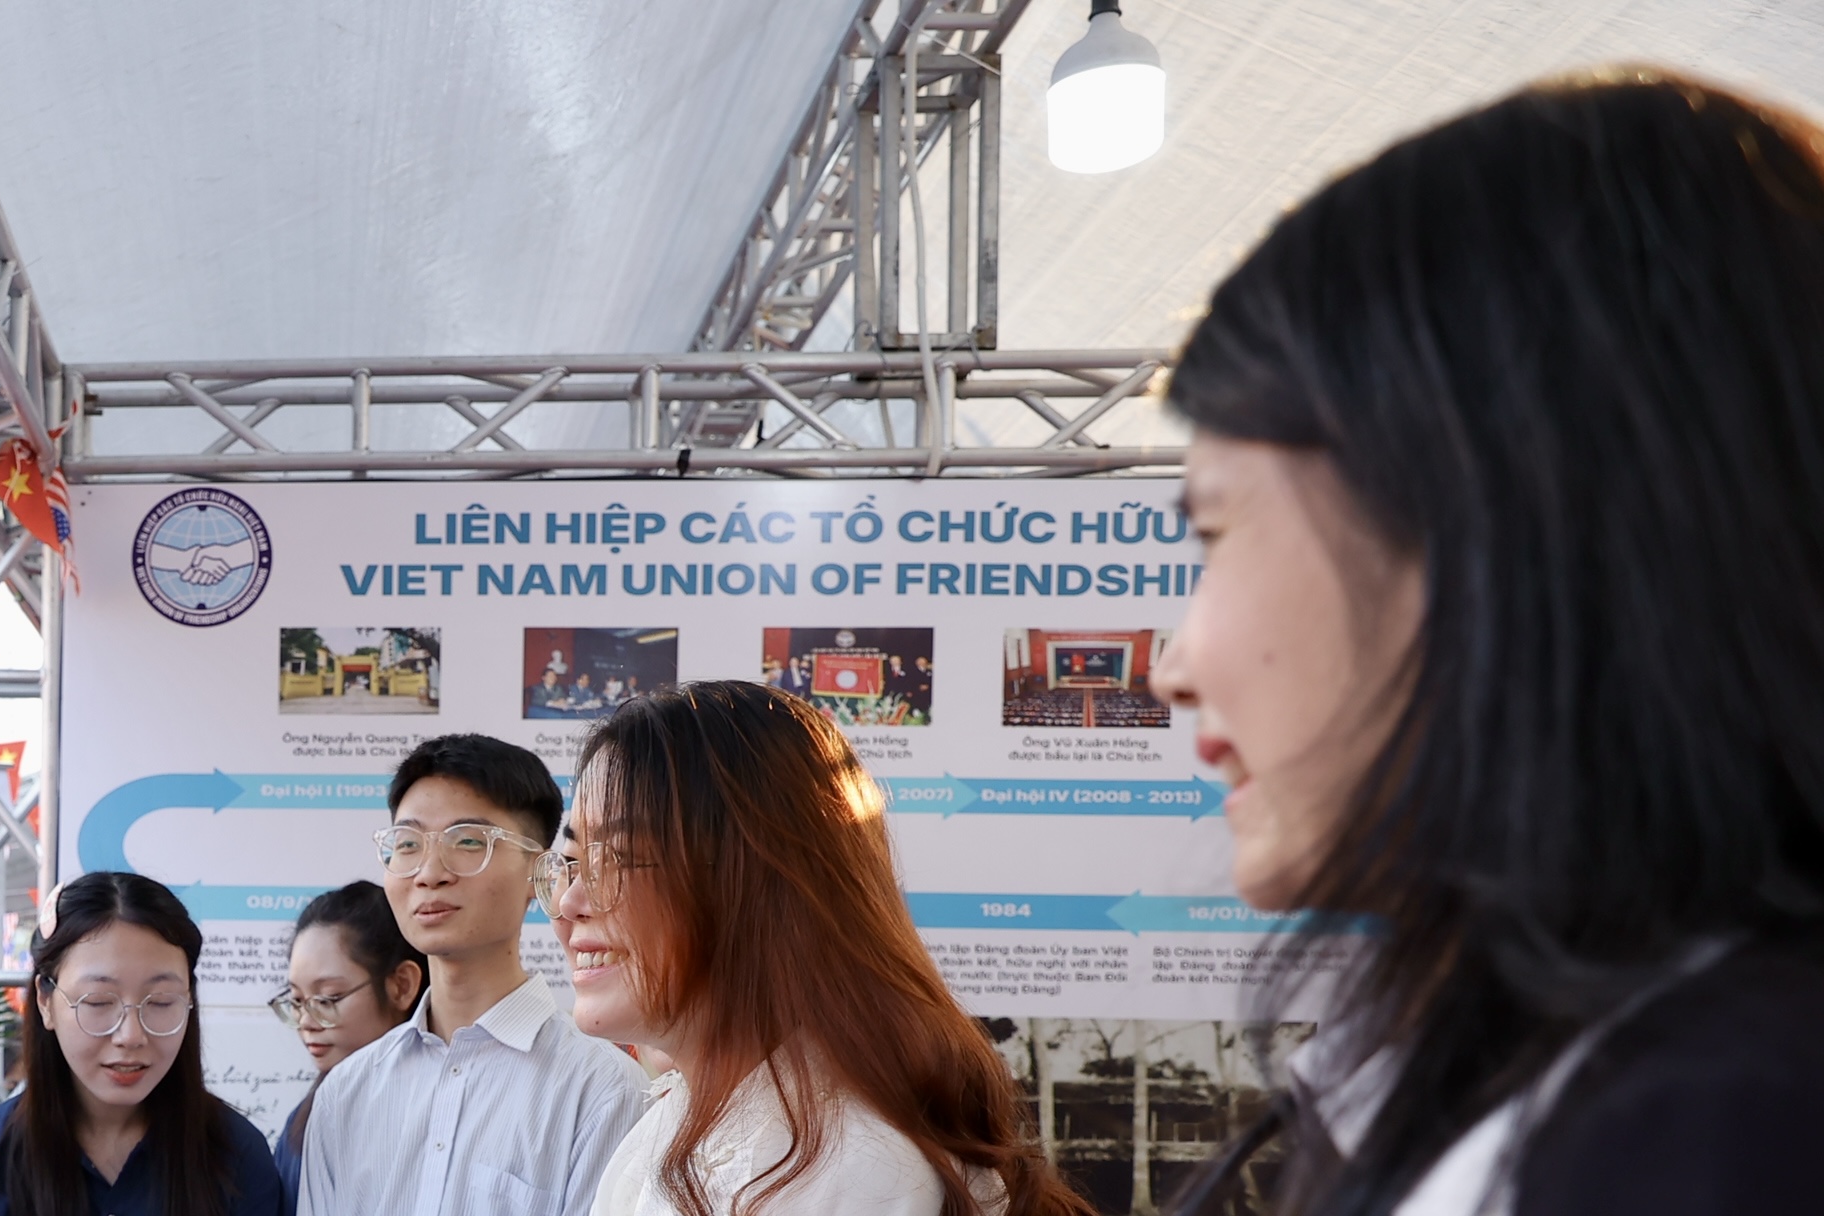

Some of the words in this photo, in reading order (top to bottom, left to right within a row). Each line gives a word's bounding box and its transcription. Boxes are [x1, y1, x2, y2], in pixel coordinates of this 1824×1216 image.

[414, 503, 531, 545] LIÊN
[545, 503, 666, 553] HIỆP
[679, 502, 797, 544] CÁC
[810, 494, 884, 544] TỔ
[897, 500, 1057, 544] CHỨC
[1071, 501, 1187, 544] HỮU
[340, 563, 464, 597] VIET
[476, 563, 608, 597] NAM
[622, 562, 796, 597] UNION
[810, 562, 883, 597] OF
[365, 733, 408, 744] Quang
[1022, 736, 1050, 750] Ông
[1075, 737, 1110, 748] Xuân
[260, 784, 291, 799] Đại
[294, 784, 323, 799] hội
[898, 787, 954, 803] 2007)
[981, 789, 1013, 804] Đại
[1016, 788, 1047, 805] hội
[1049, 789, 1070, 804] IV
[1073, 789, 1132, 805] (2008
[1148, 790, 1202, 806] 2013)
[979, 902, 1032, 918] 1984
